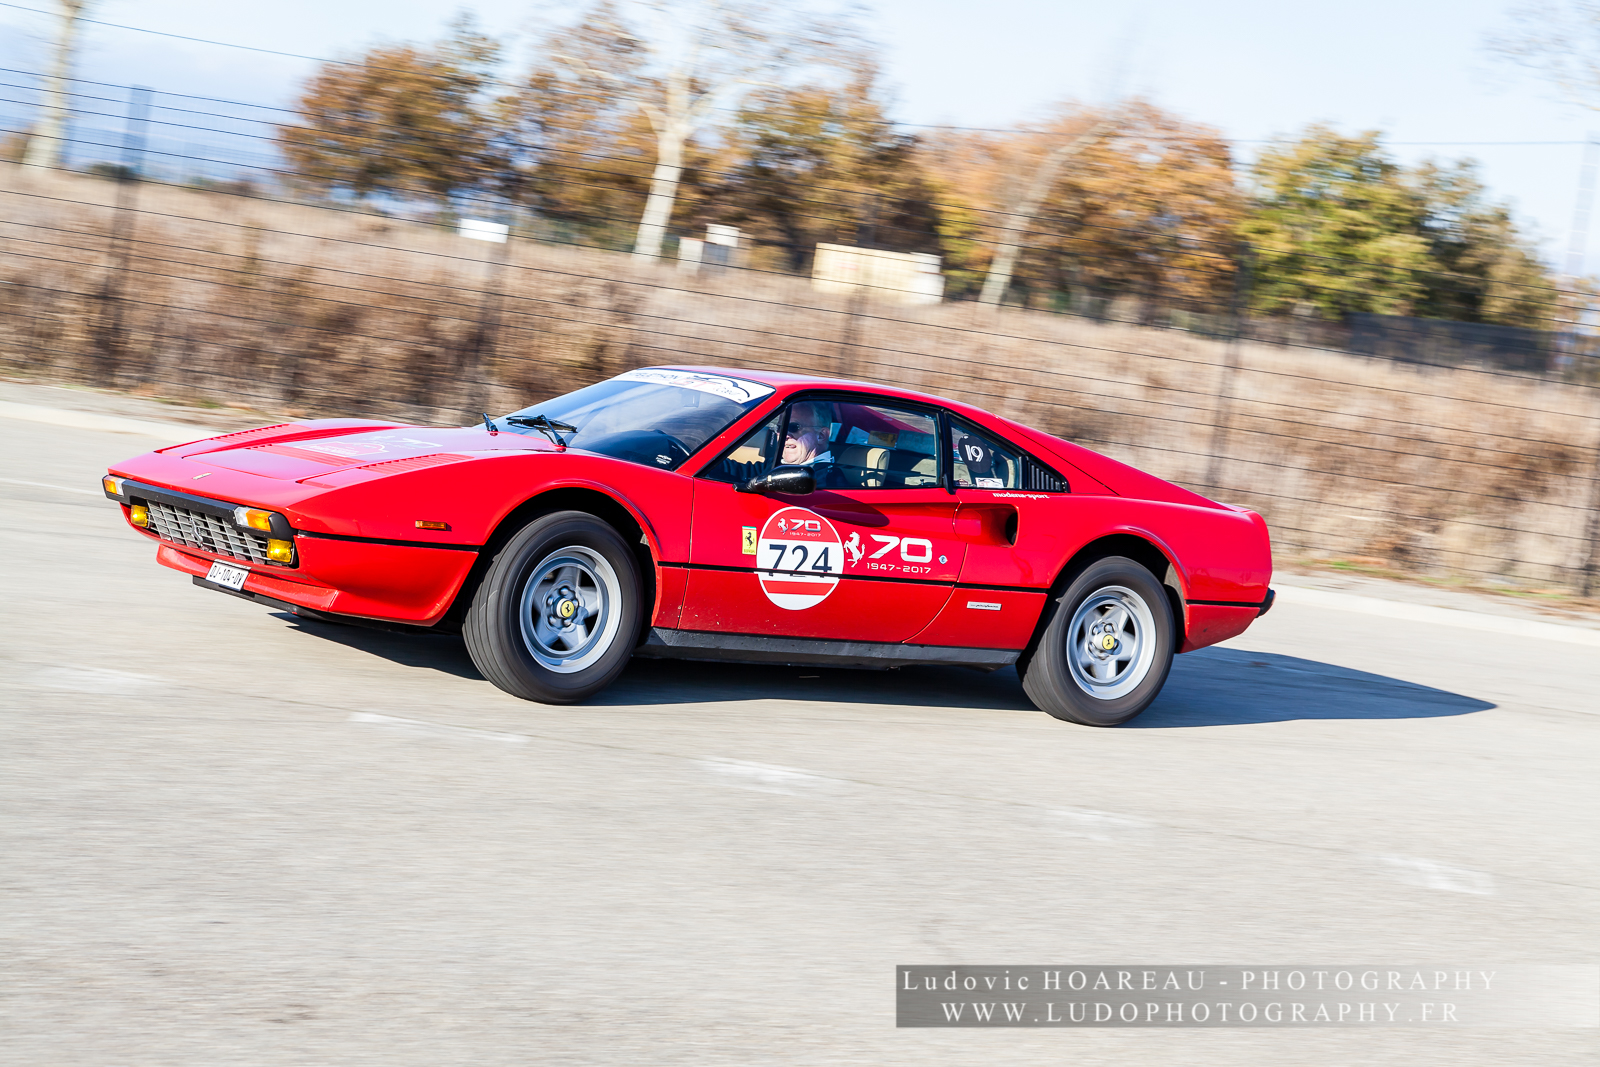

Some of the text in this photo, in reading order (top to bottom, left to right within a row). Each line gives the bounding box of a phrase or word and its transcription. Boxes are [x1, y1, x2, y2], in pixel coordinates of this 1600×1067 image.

[789, 518, 821, 532] 70
[870, 534, 933, 563] 70
[768, 543, 833, 578] 724
[866, 562, 932, 574] 1947-2017
